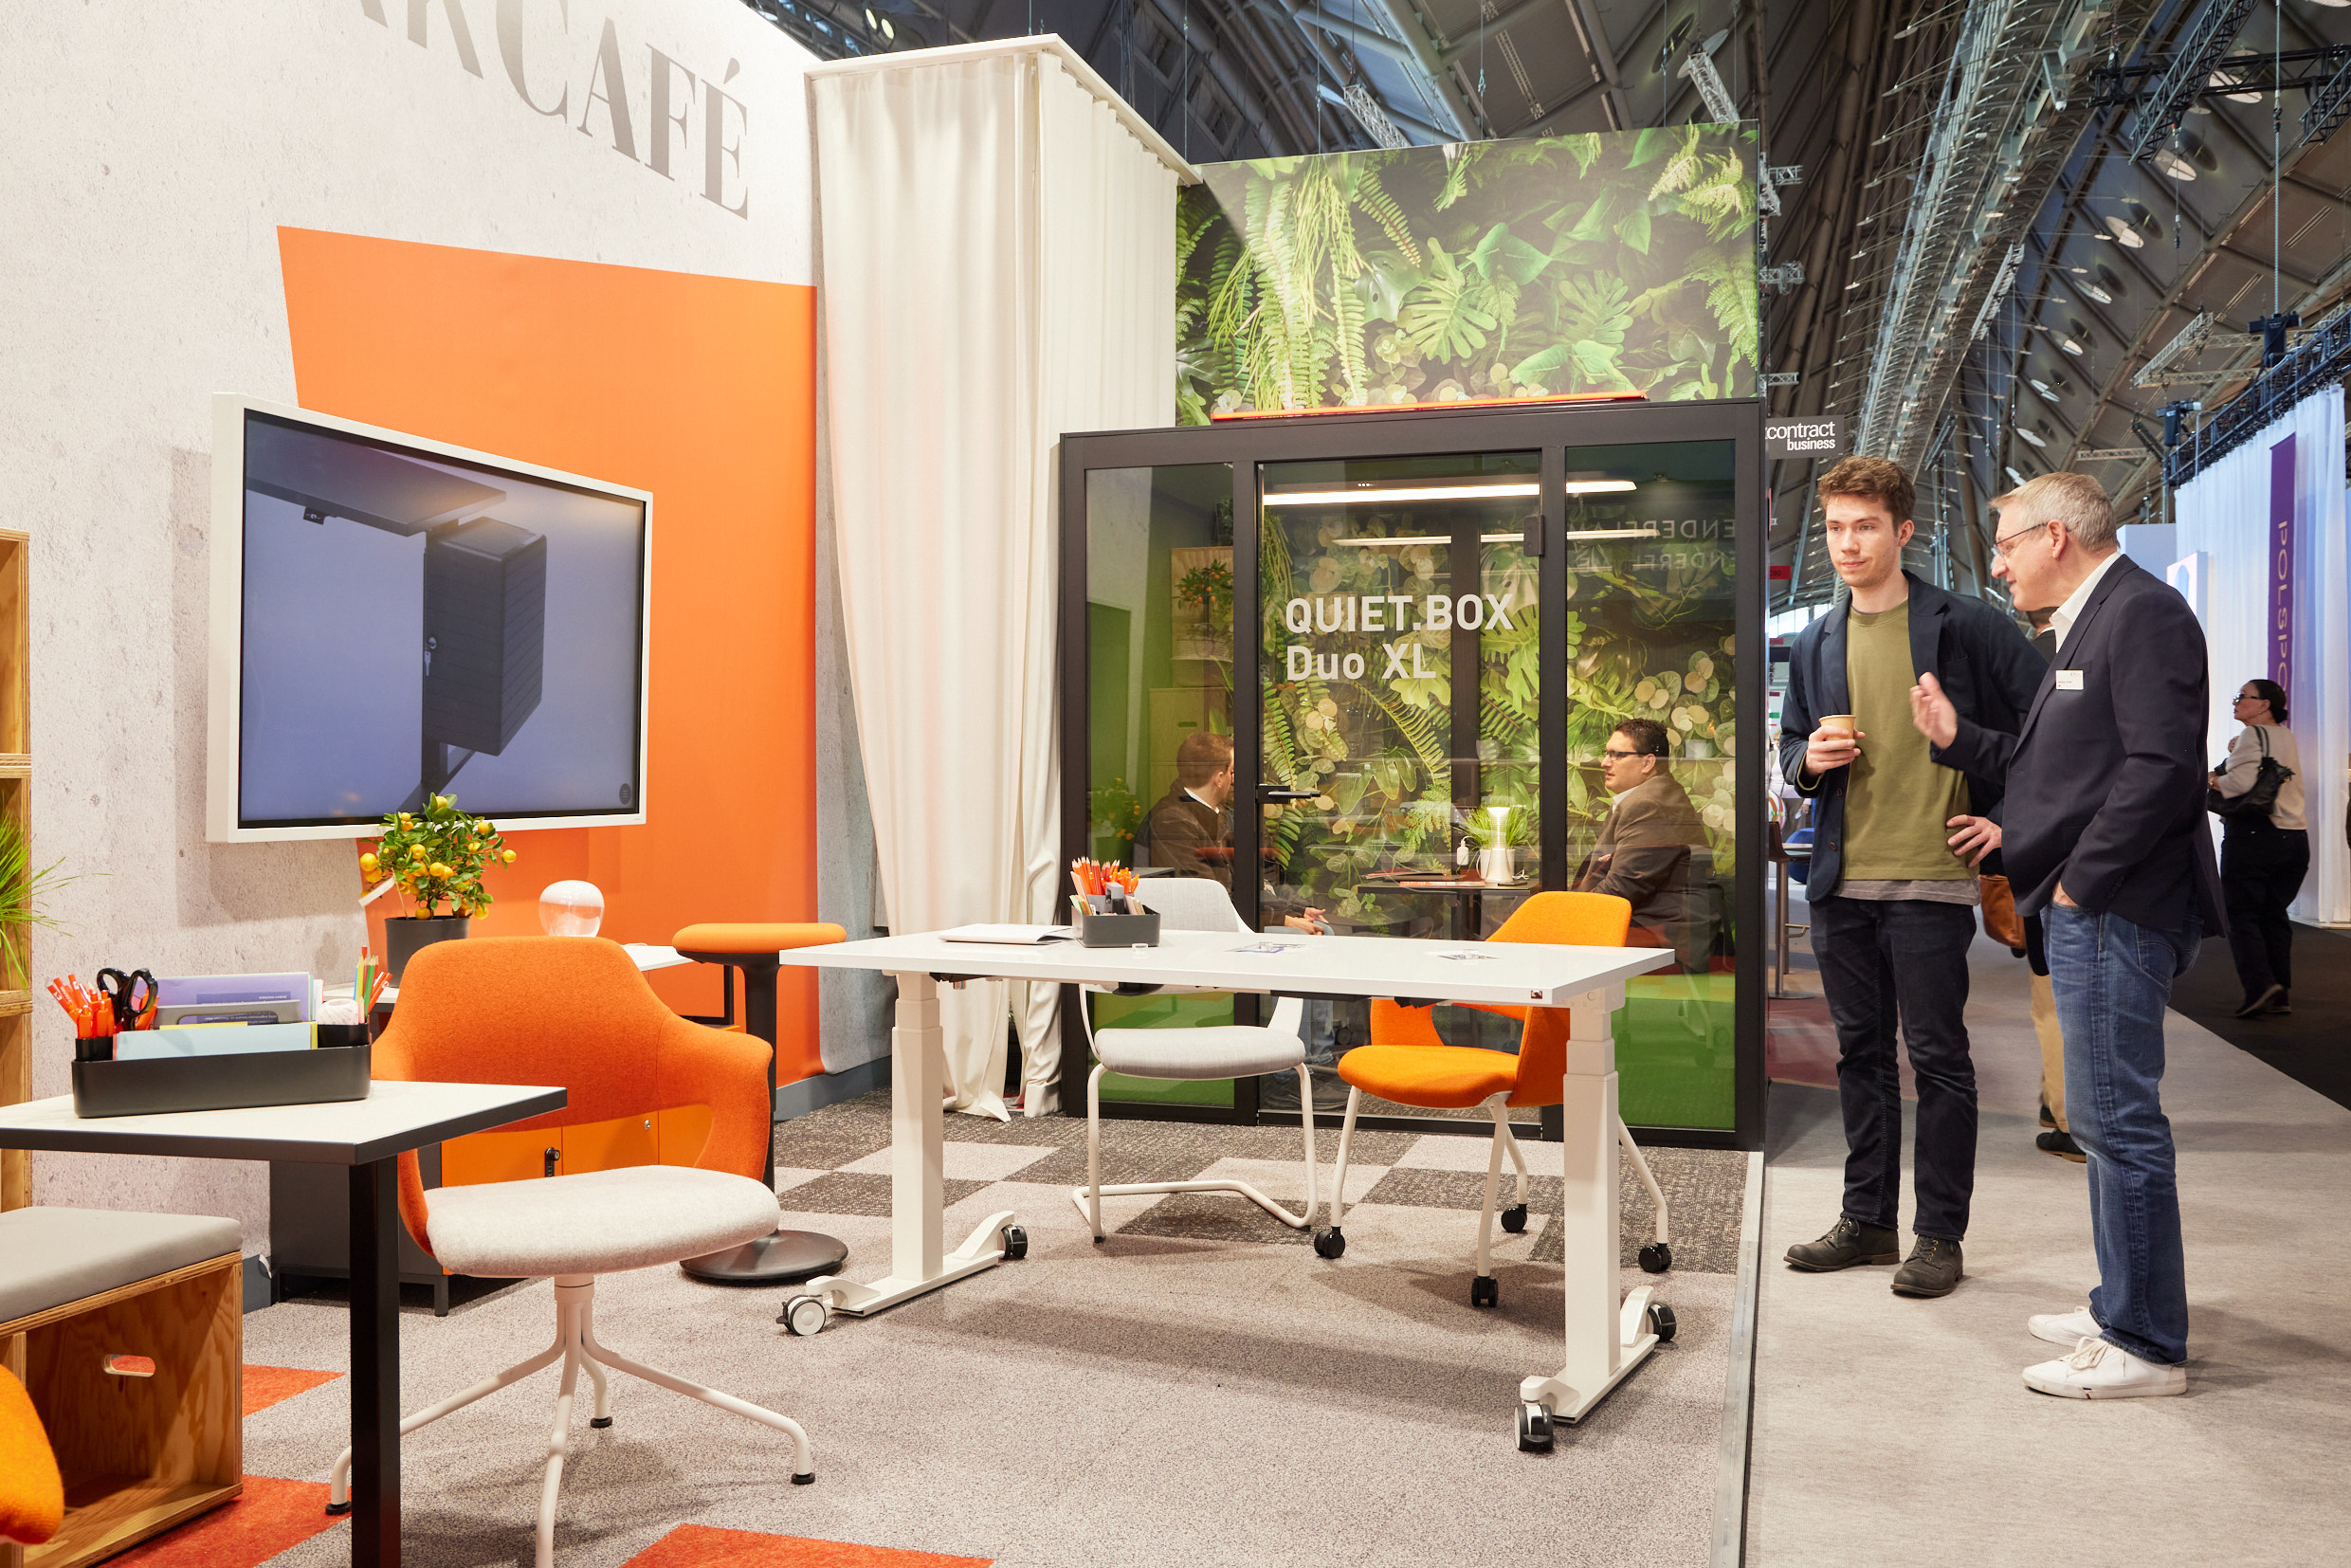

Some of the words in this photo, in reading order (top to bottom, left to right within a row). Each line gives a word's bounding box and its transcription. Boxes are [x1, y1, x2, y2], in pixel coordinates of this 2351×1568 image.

[1765, 421, 1835, 440] contract
[1787, 437, 1836, 451] business
[1285, 593, 1514, 634] QUIET.BOX
[1286, 646, 1365, 681] Duo
[1381, 643, 1437, 680] XL
